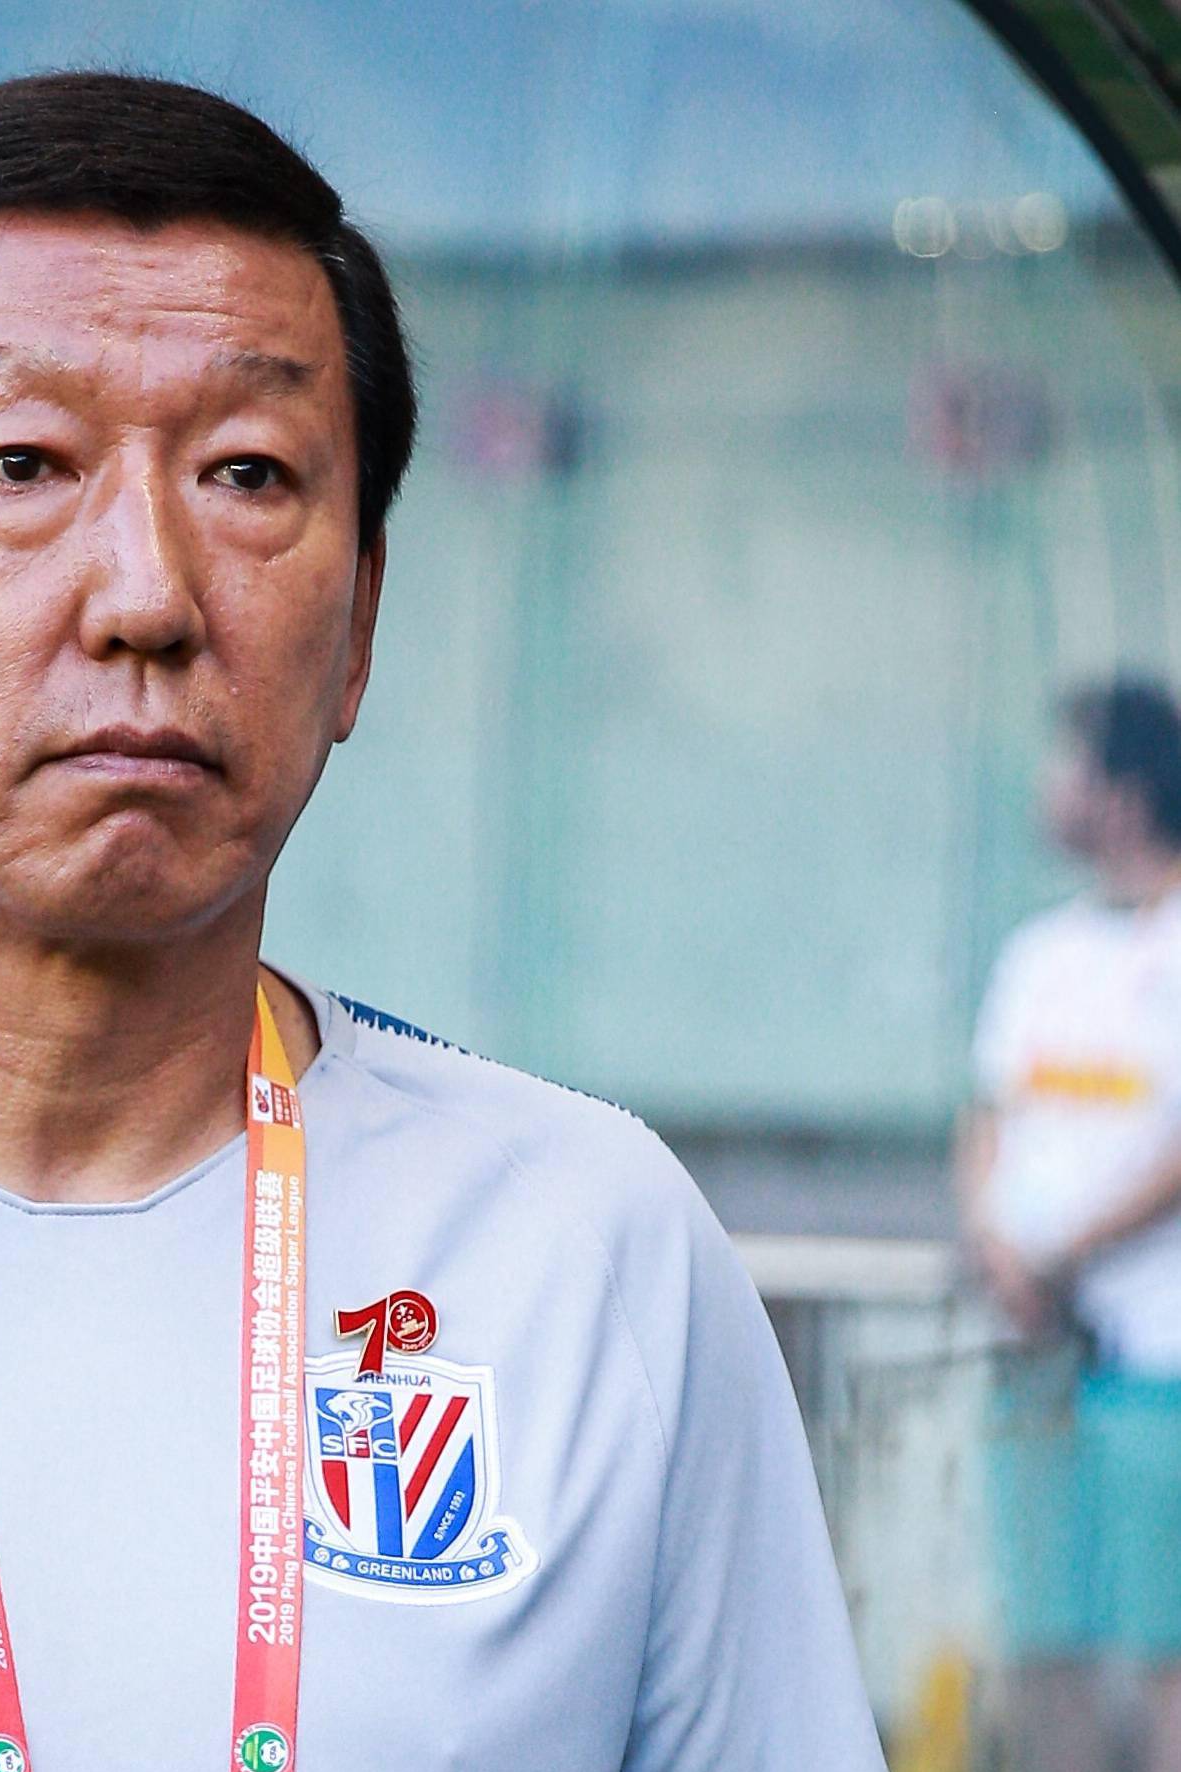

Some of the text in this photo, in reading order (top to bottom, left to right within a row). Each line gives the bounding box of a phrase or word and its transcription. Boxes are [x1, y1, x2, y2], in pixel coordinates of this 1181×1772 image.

[278, 1175, 301, 1646] 2019 Ping An Chinese Football Association Super League
[321, 1434, 397, 1458] SFC
[433, 1511, 455, 1542] SINCE
[357, 1561, 453, 1581] GREENLAND
